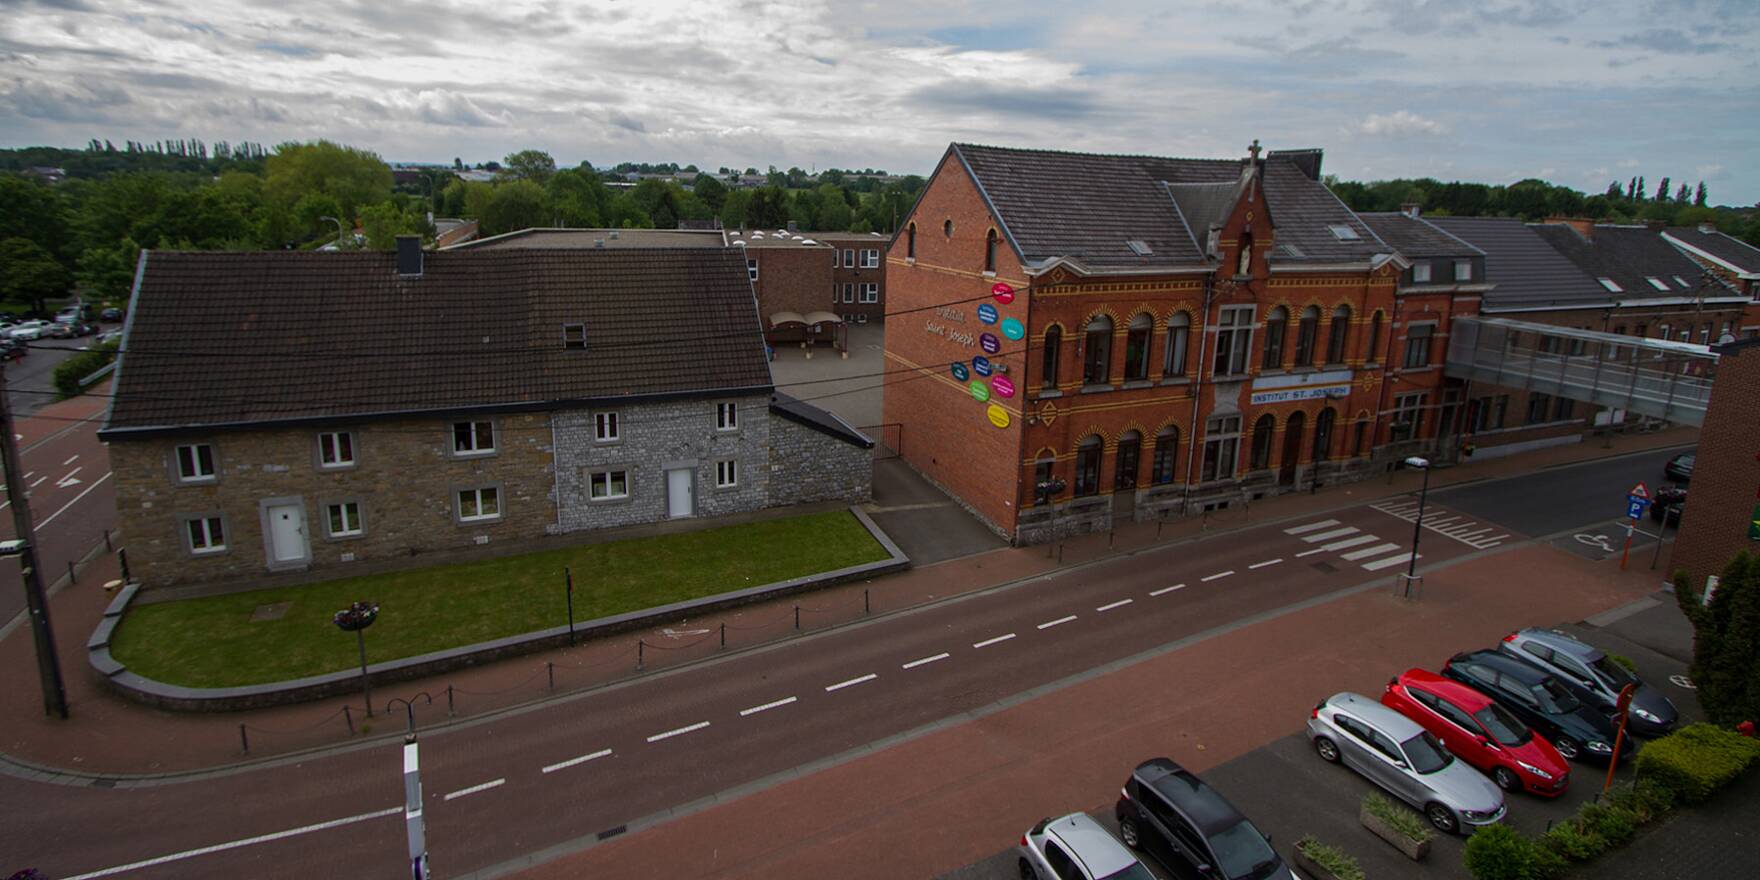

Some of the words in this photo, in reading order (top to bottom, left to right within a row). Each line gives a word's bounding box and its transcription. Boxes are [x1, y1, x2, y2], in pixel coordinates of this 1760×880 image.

[926, 320, 945, 335] Saint
[948, 328, 975, 347] Joseph
[1254, 392, 1288, 402] INSTITUT
[1293, 391, 1307, 399] ST.
[1311, 387, 1346, 397] JOSEPH
[1632, 503, 1641, 512] P
